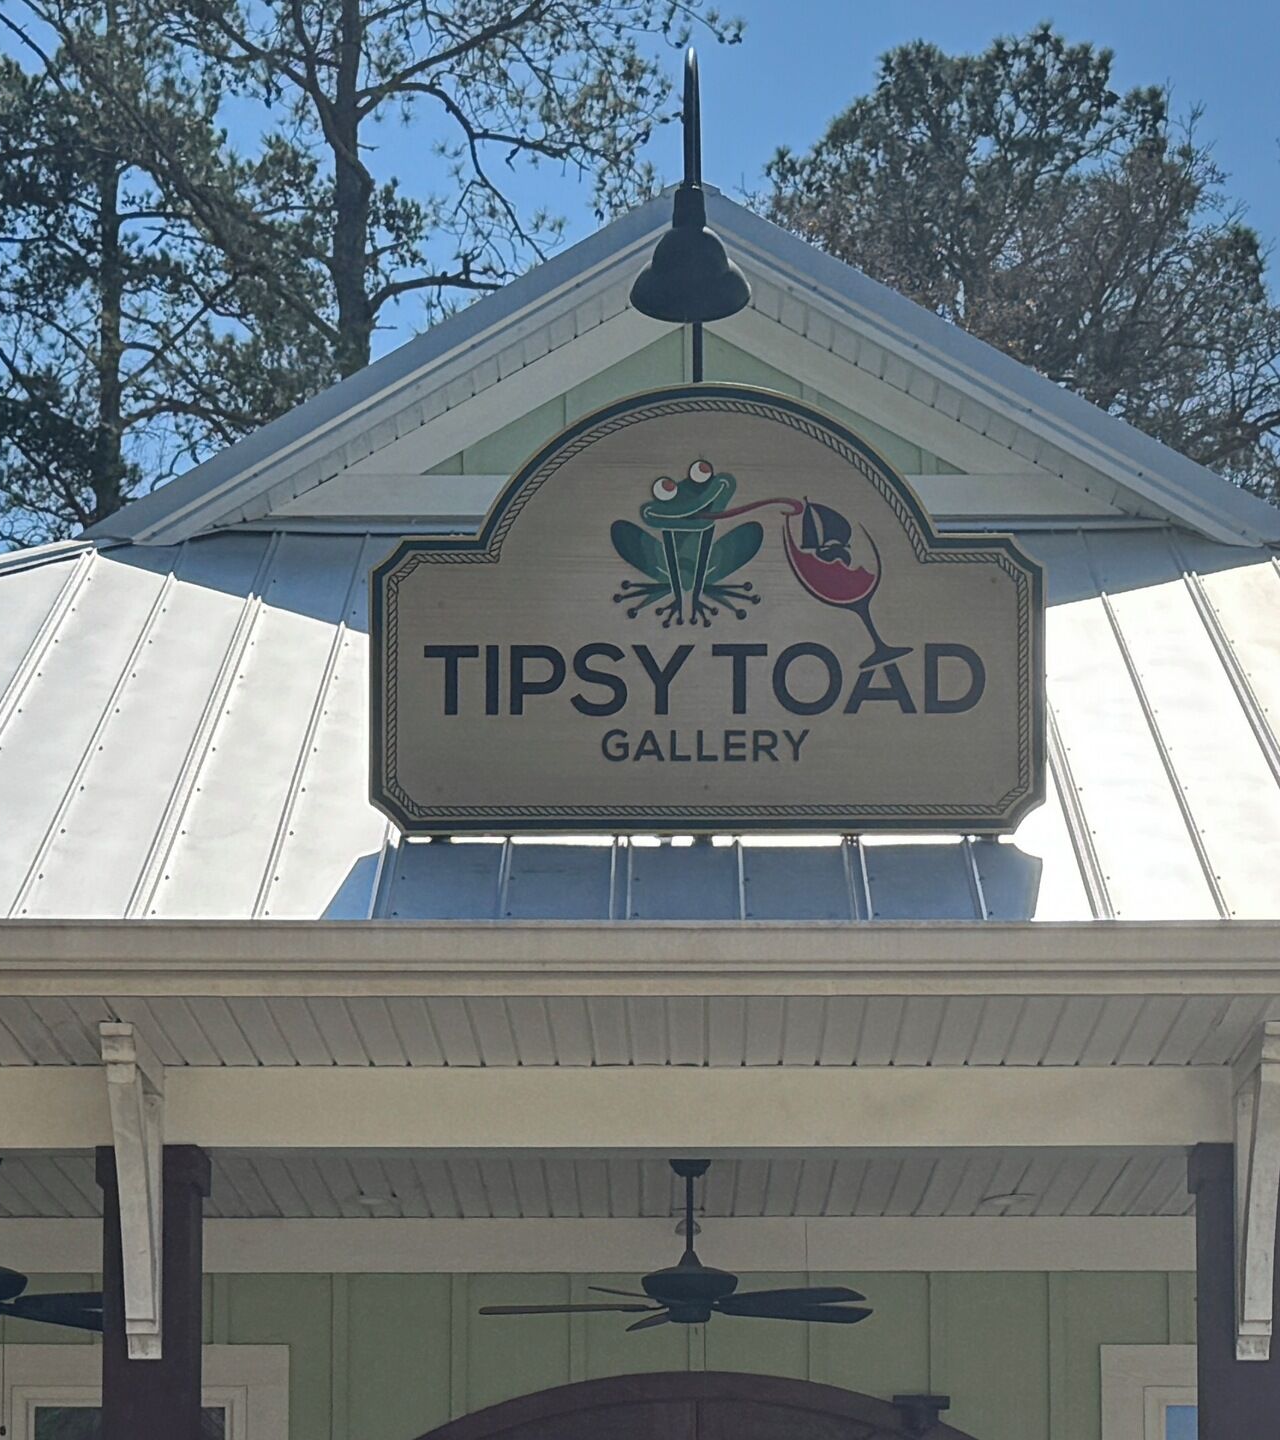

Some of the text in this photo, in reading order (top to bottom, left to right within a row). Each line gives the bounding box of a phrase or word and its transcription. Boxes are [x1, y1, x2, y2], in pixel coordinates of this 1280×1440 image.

[424, 642, 986, 716] TIPSY TOAD
[601, 728, 809, 763] GALLERY
